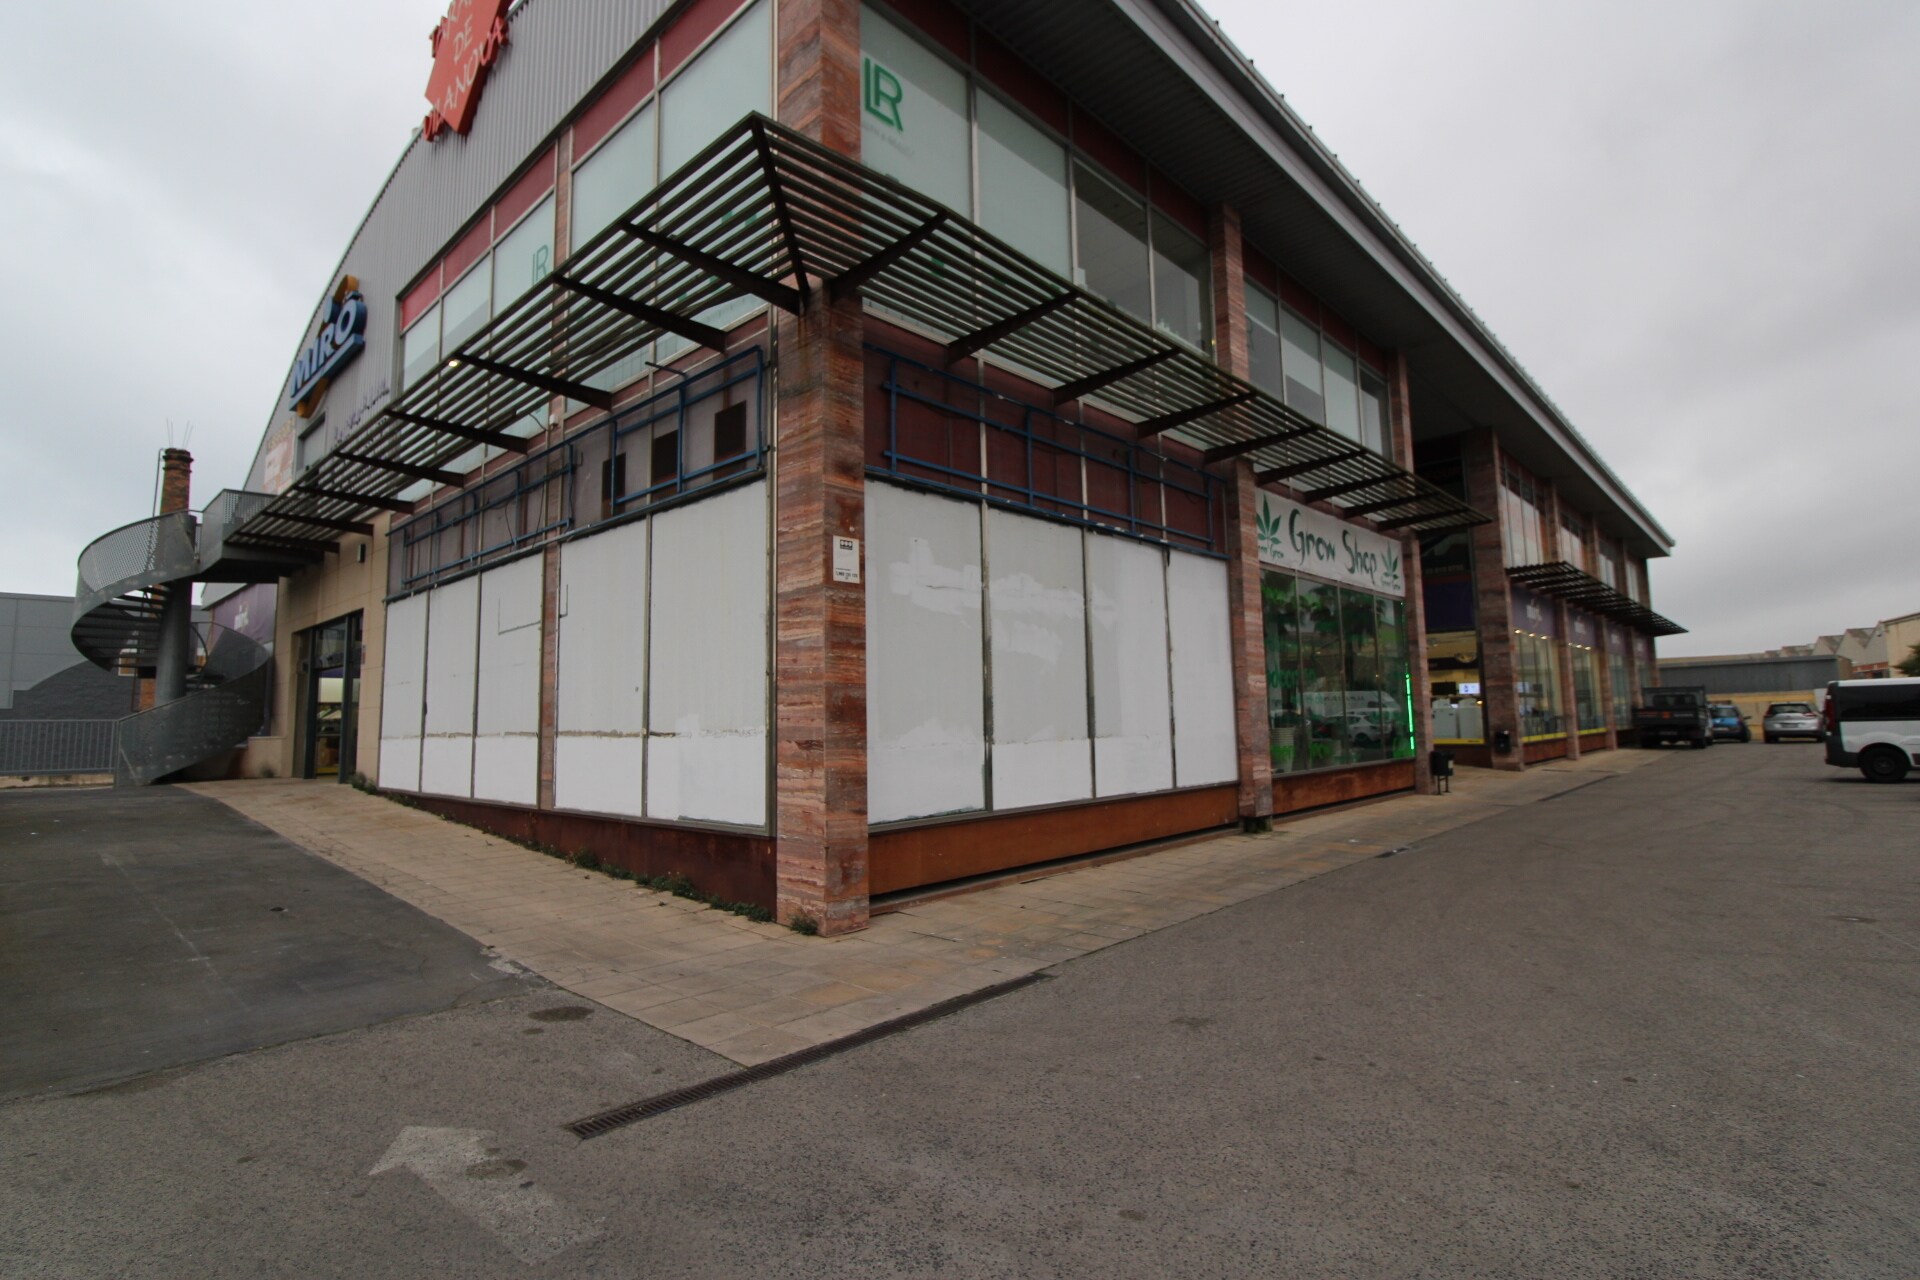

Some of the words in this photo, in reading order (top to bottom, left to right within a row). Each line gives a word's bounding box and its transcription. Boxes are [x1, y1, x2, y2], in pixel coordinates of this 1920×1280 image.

[453, 15, 473, 64] DE
[864, 57, 903, 132] LR
[1289, 508, 1335, 566] Grow
[1342, 529, 1377, 584] Shop
